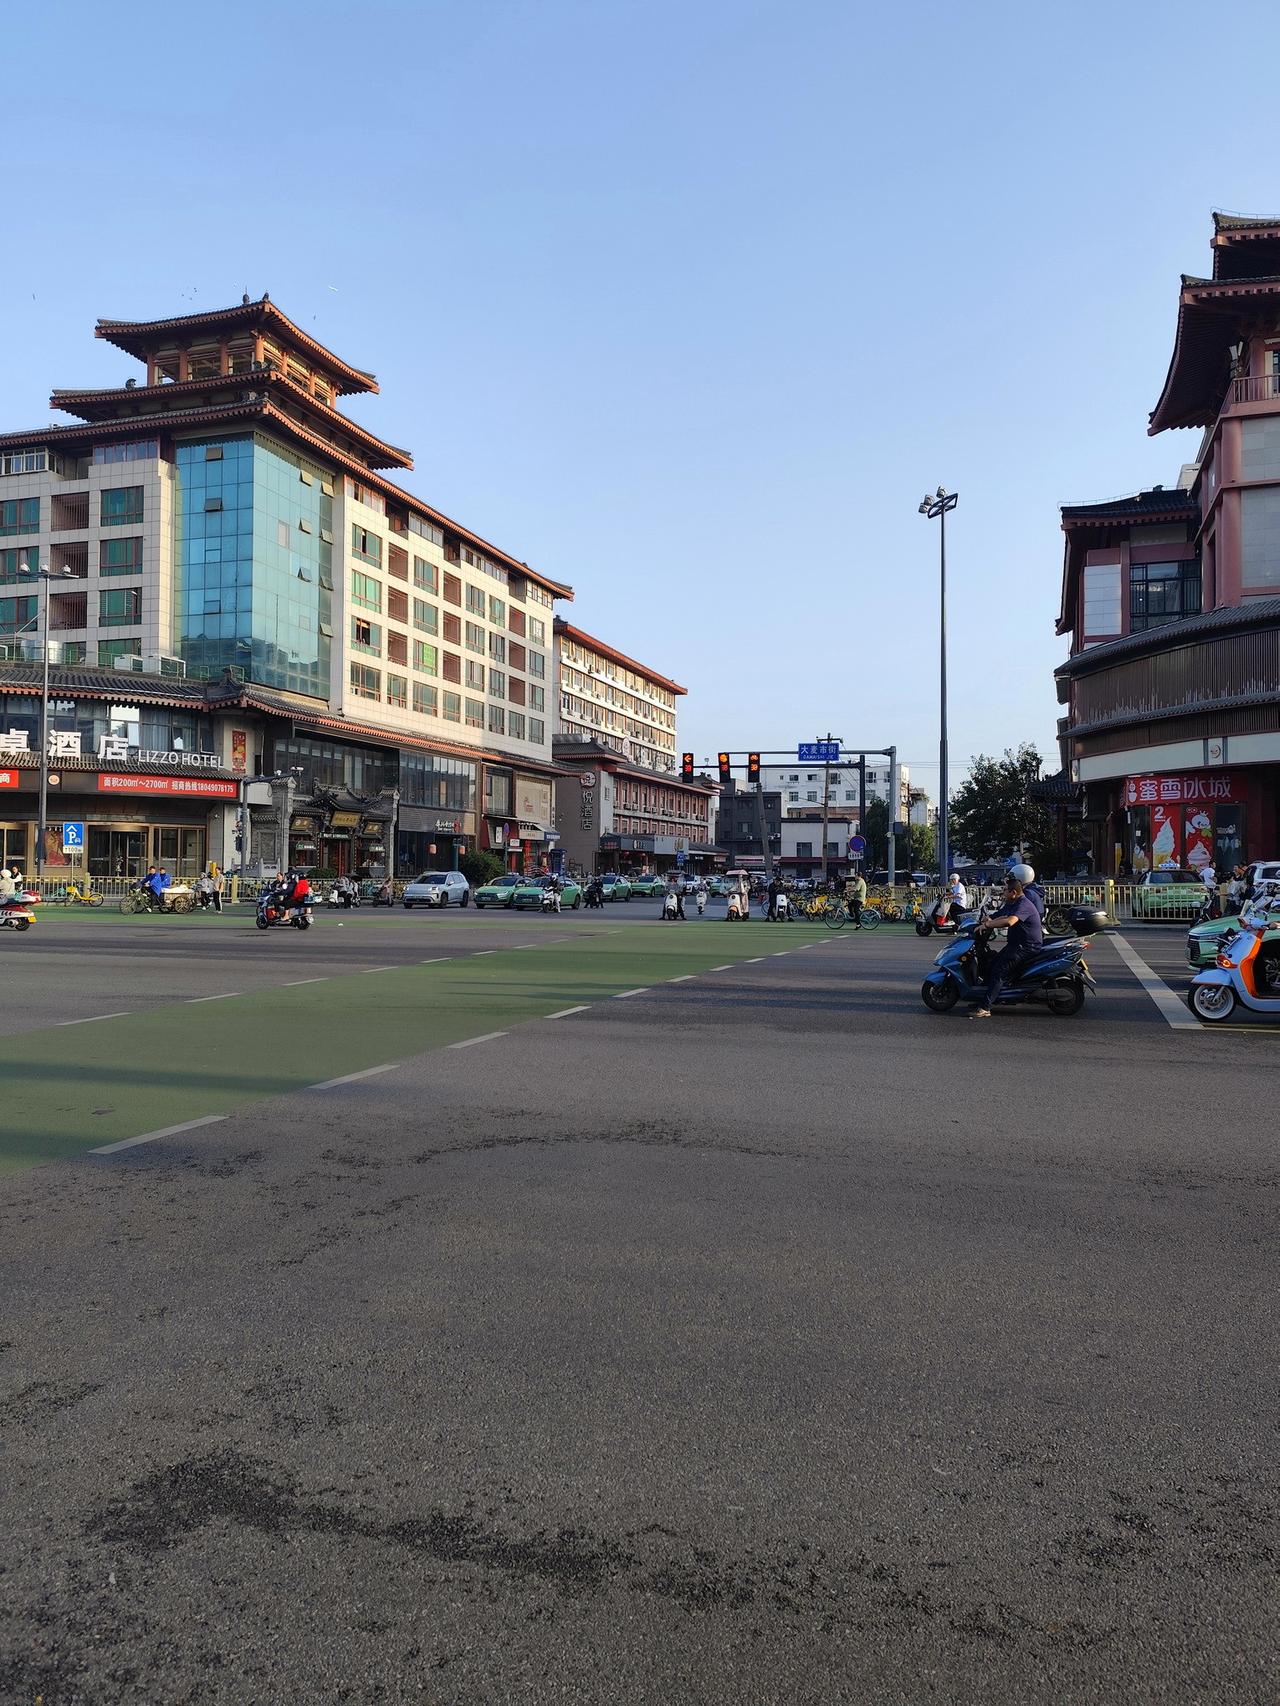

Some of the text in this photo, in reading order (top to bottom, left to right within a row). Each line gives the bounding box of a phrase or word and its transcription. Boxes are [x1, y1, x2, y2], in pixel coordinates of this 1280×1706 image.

[801, 745, 837, 754] 大麦市街
[138, 750, 224, 768] LIZZO HOTEL
[1139, 777, 1232, 801] 蜜雪冰城
[1154, 806, 1164, 818] 2
[68, 831, 77, 843] P
